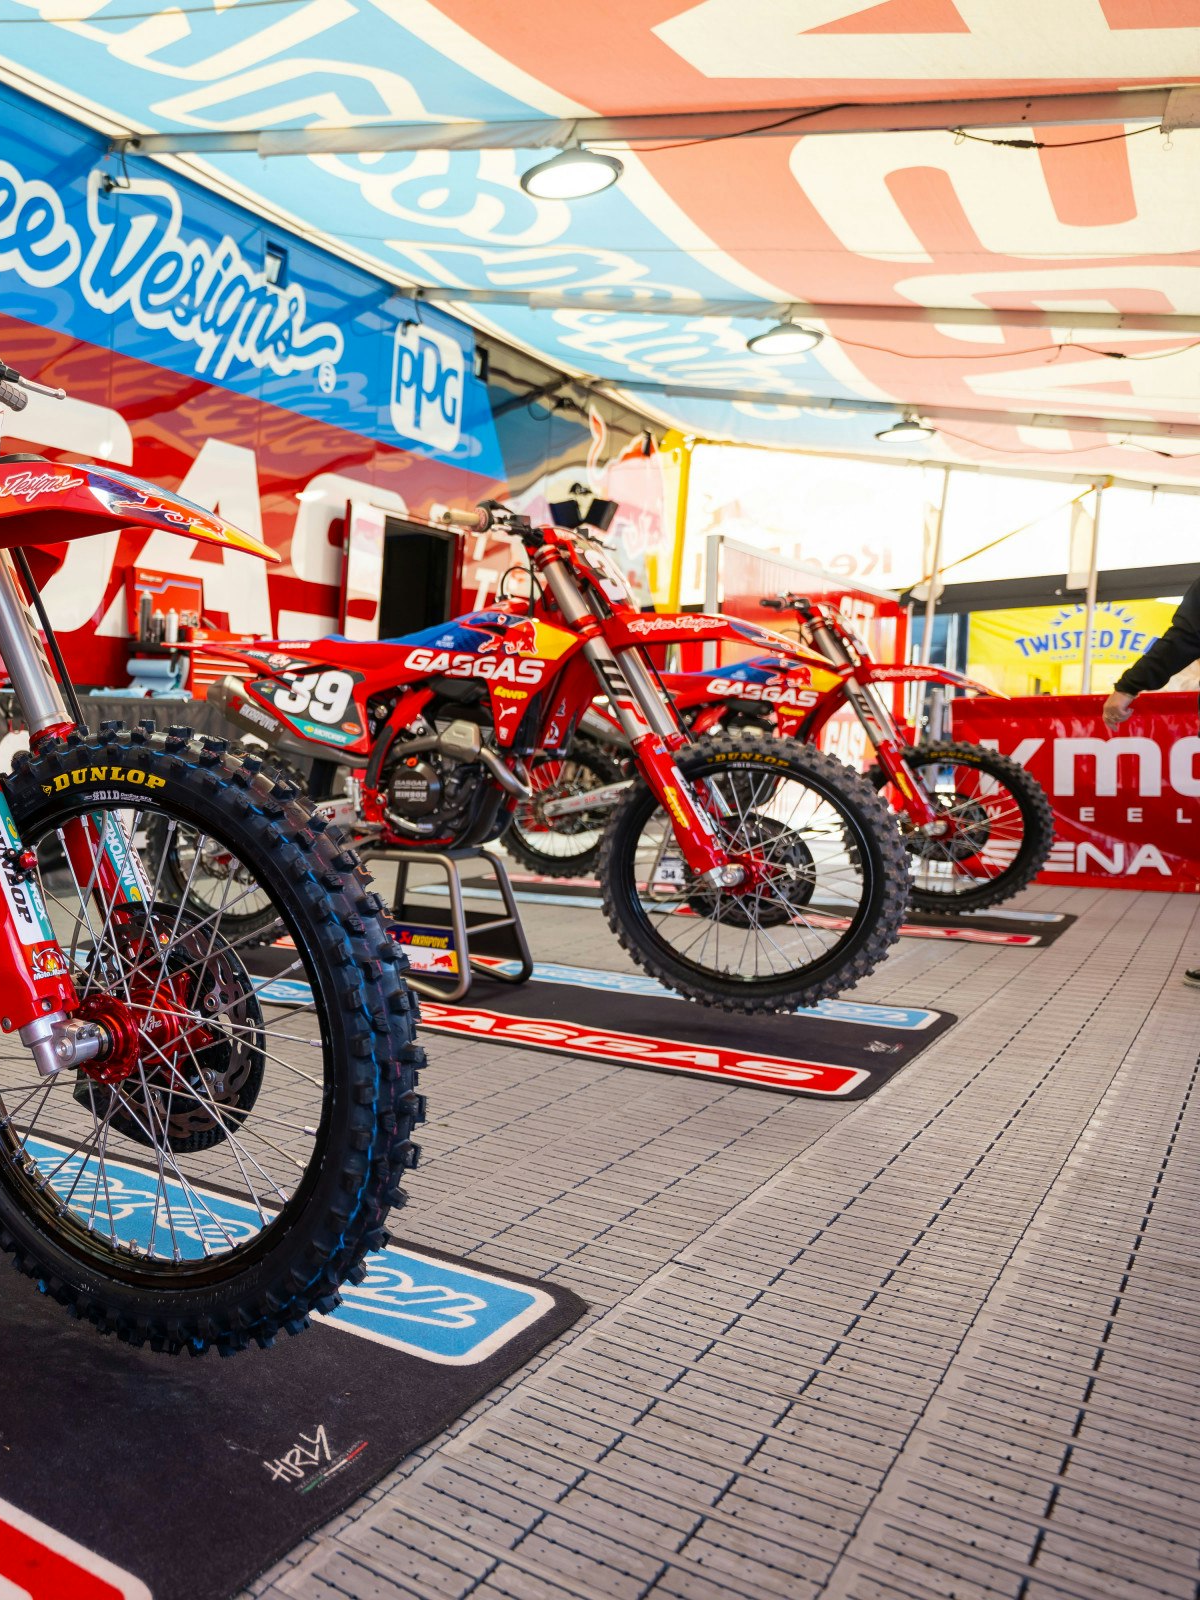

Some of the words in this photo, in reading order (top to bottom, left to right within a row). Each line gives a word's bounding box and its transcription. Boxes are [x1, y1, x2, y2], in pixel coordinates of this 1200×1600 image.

[0, 472, 85, 503] Designs
[404, 649, 546, 684] GASGAS
[273, 663, 356, 724] 39
[706, 677, 819, 708] GASGAS
[53, 766, 167, 792] DUNLOP
